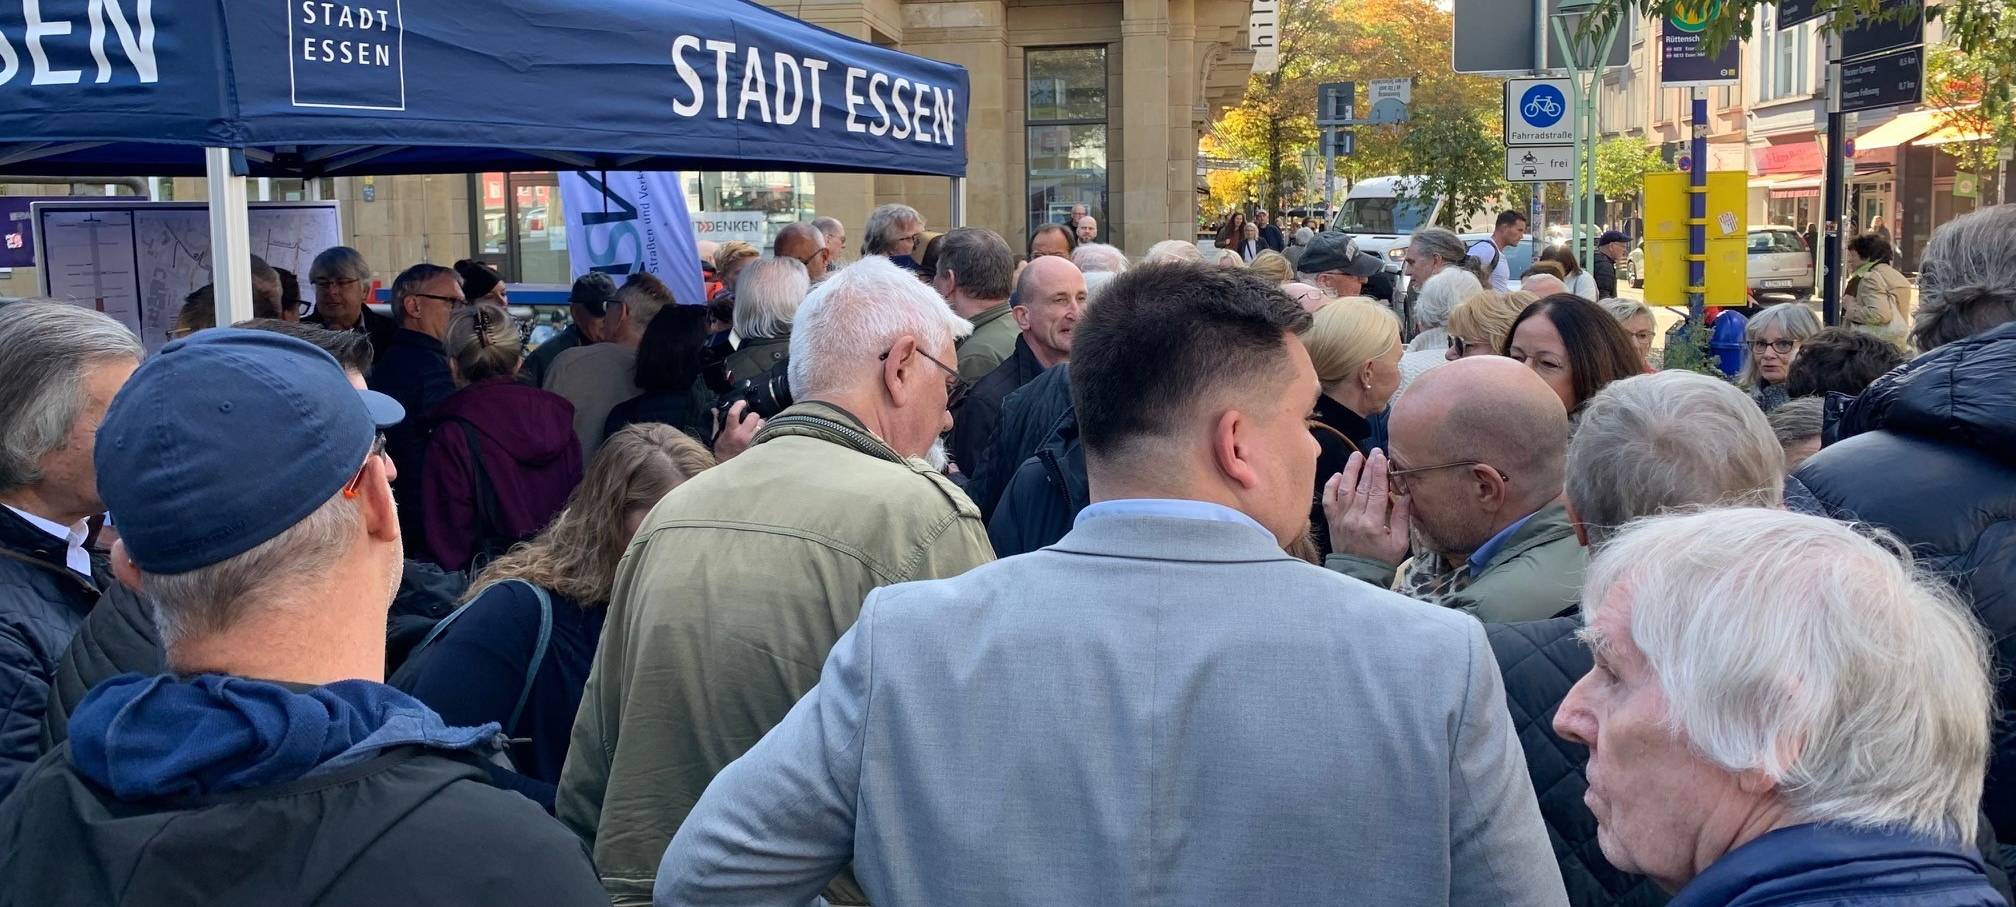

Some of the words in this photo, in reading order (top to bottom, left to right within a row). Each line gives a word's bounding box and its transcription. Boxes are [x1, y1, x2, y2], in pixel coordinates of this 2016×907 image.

[303, 1, 388, 31] STADT
[1251, 0, 1274, 47] hil
[0, 0, 158, 86] EN
[304, 37, 390, 66] ESSEN
[1666, 35, 1700, 44] Rüttensch
[671, 35, 828, 128] STADT
[846, 67, 954, 146] ESSEN
[1512, 131, 1573, 140] Fahrradstraße
[1550, 159, 1568, 168] frei
[637, 171, 649, 200] Verk
[639, 203, 652, 224] und
[645, 228, 660, 274] Straßen
